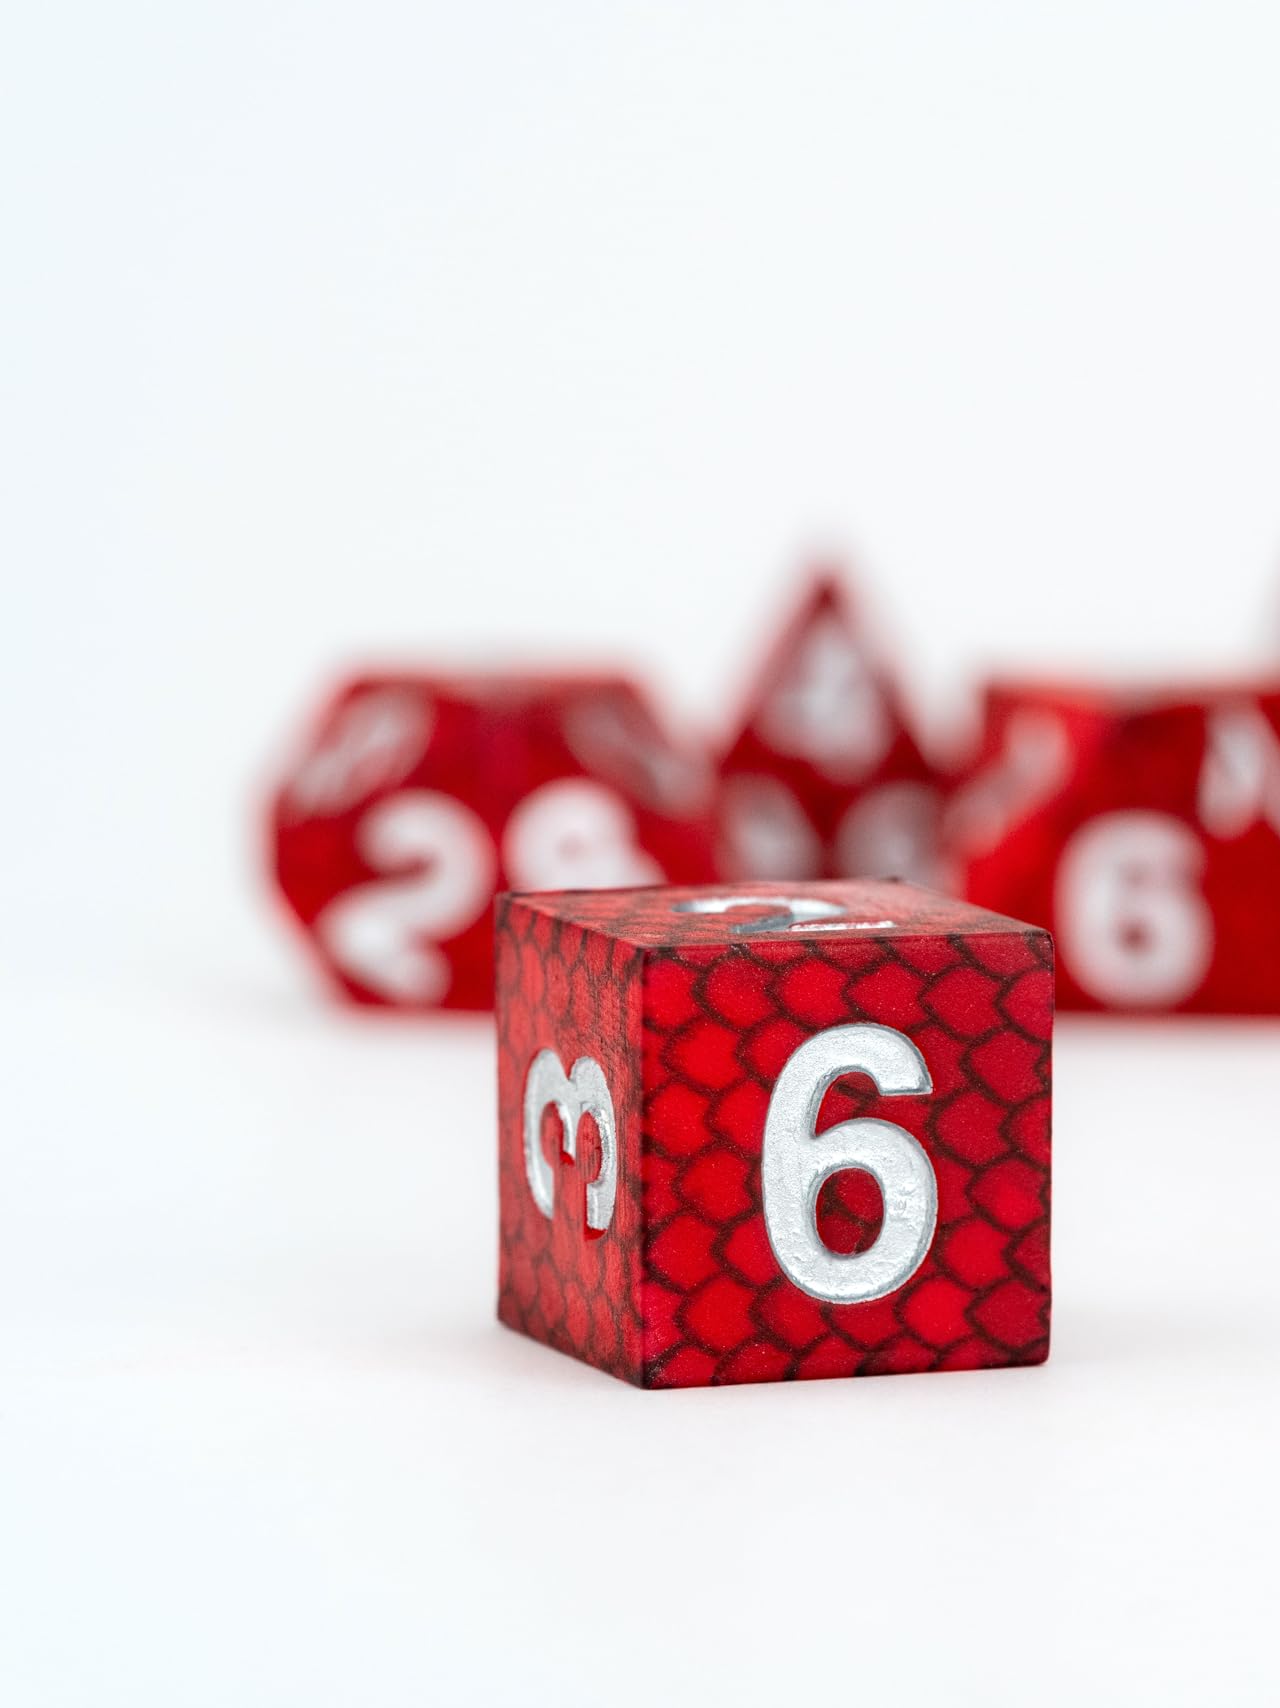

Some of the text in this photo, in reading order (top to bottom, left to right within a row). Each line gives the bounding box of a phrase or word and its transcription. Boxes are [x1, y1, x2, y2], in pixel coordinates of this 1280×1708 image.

[322, 789, 494, 1002] 2
[673, 897, 895, 933] 2
[1056, 811, 1211, 1006] 6
[523, 1046, 617, 1231] 3
[761, 1022, 939, 1304] 6
